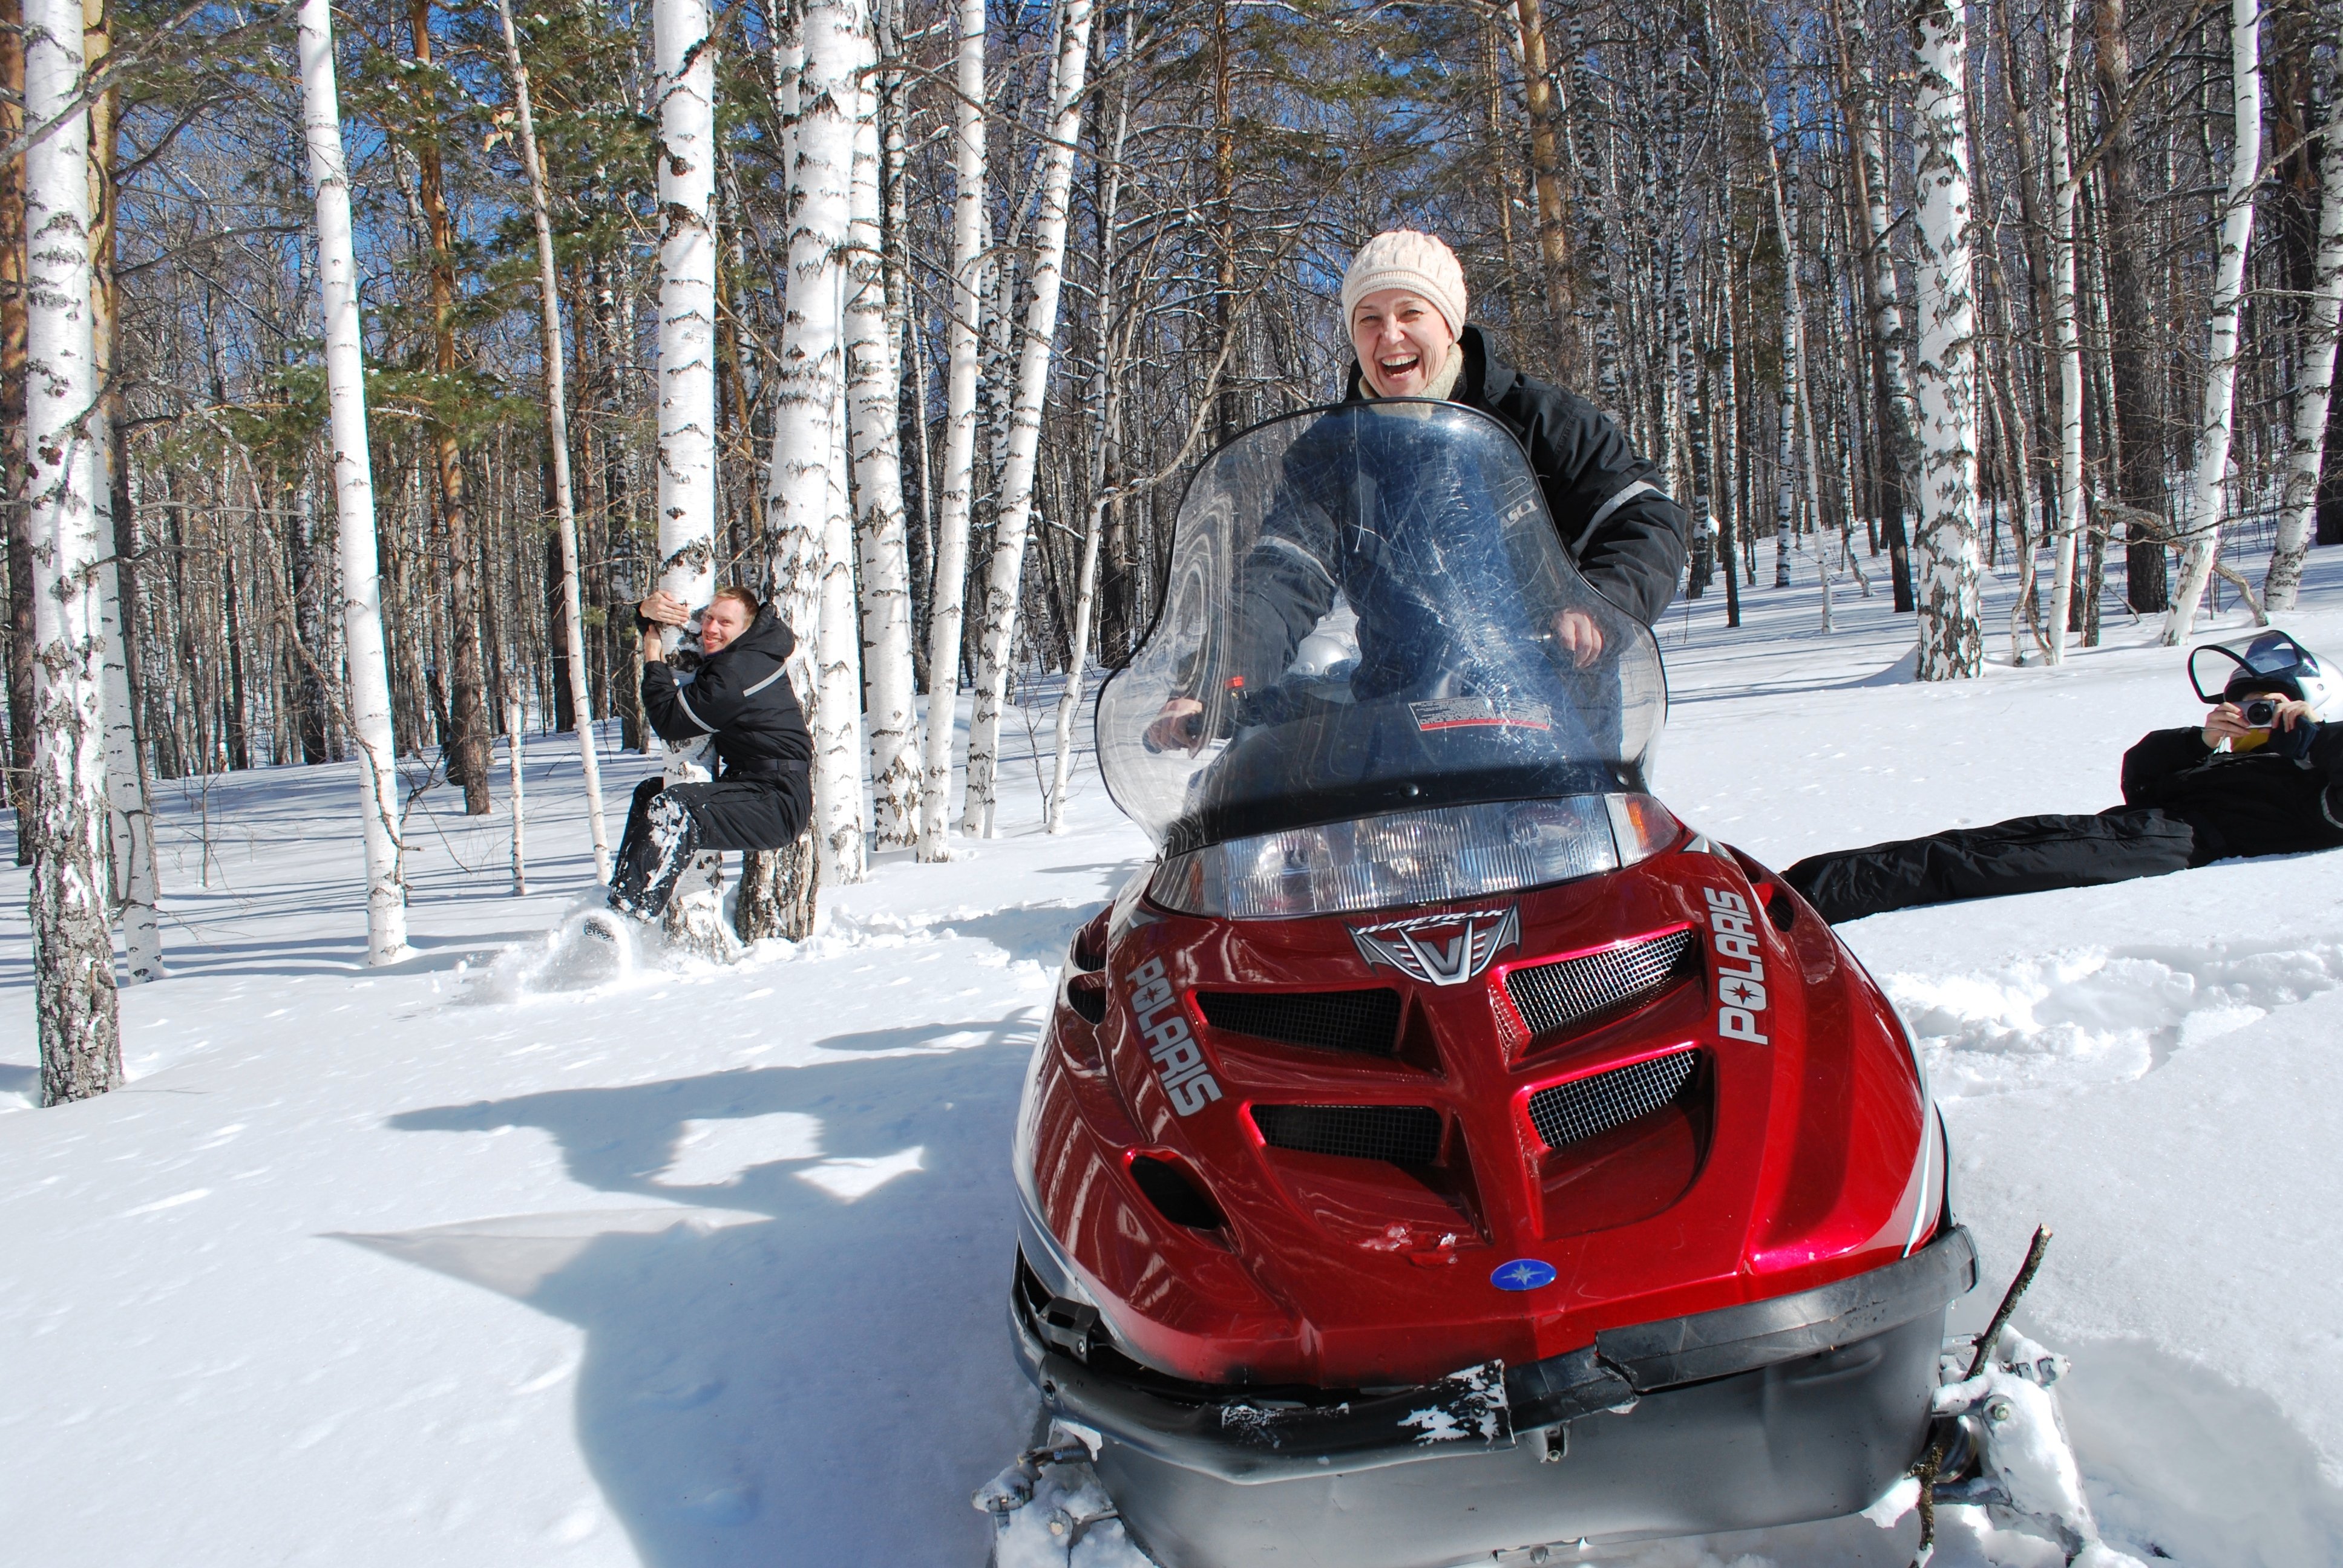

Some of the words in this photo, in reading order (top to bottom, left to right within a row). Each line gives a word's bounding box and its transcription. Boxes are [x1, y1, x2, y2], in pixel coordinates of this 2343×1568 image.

[1355, 909, 1508, 935] WIDETRAK
[1406, 920, 1461, 932] LX
[1703, 887, 1768, 1045] POLARIS
[1125, 956, 1224, 1117] POLARIS
